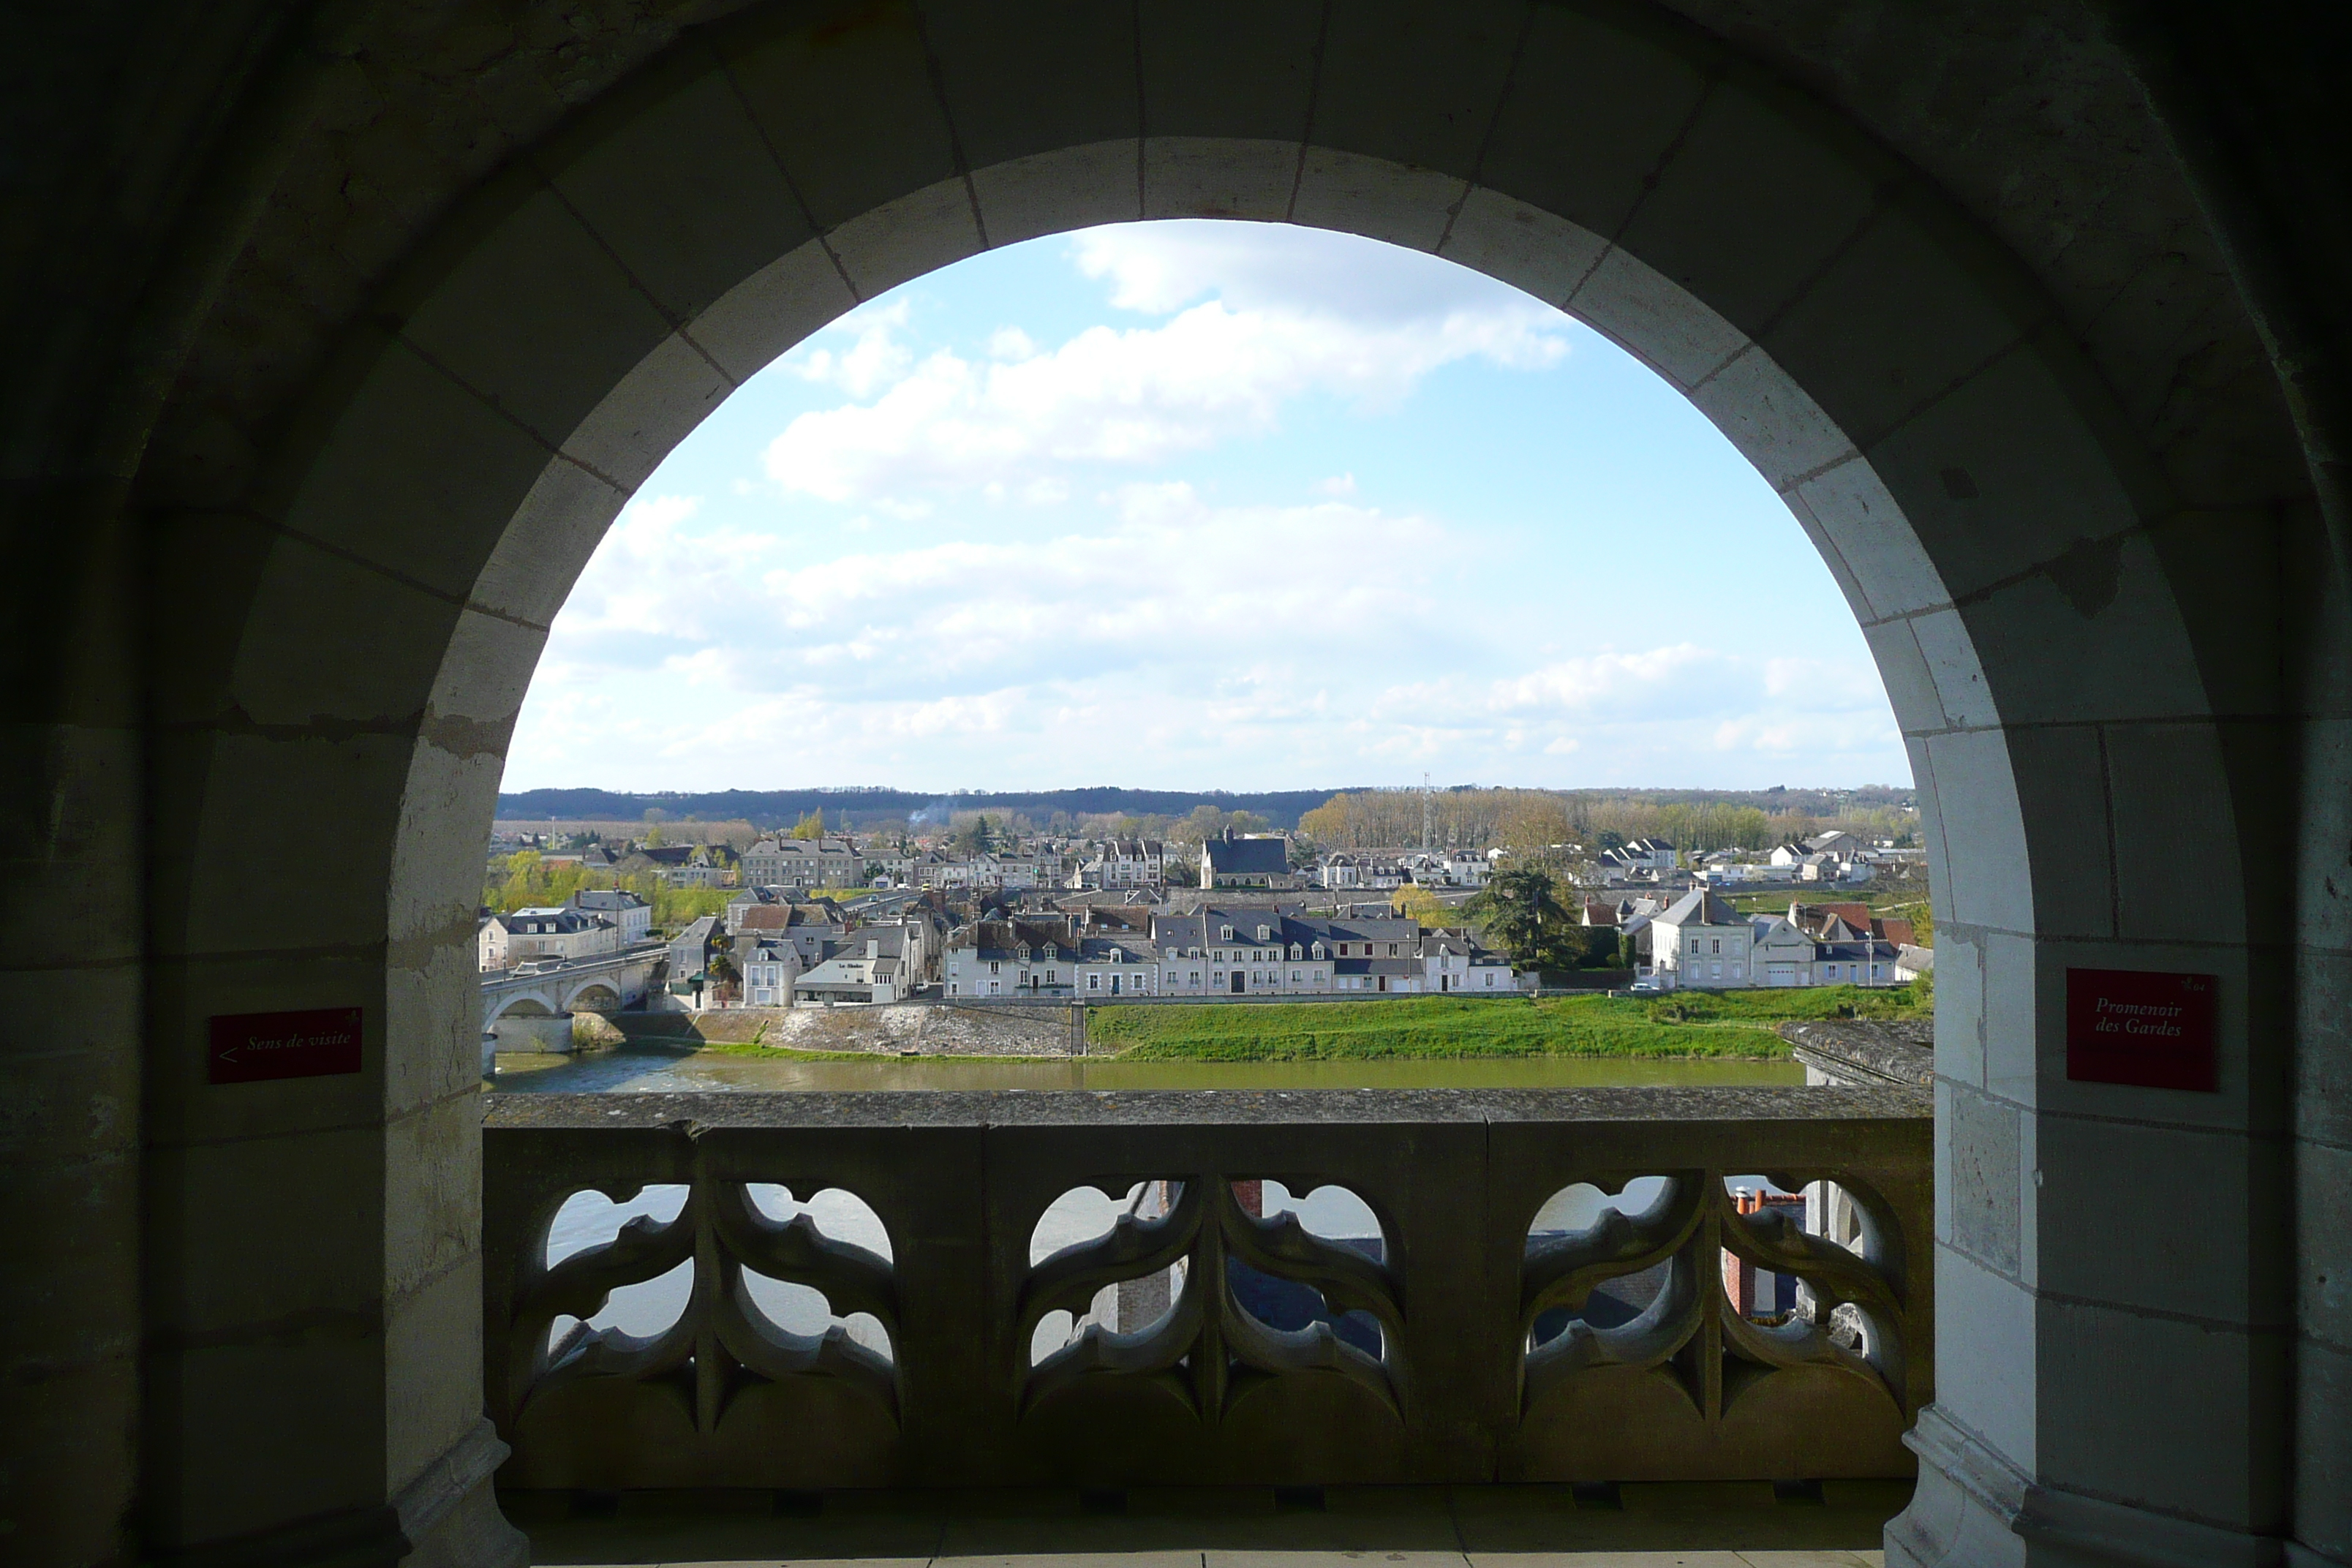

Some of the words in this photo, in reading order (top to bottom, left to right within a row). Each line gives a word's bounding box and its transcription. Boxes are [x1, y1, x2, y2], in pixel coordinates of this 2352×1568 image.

[2095, 997, 2182, 1017] Promenoir
[2095, 1017, 2119, 1032] des
[2125, 1018, 2182, 1037] Gardes
[246, 1036, 282, 1051] Sens
[286, 1033, 304, 1048] de
[308, 1030, 351, 1047] visite
